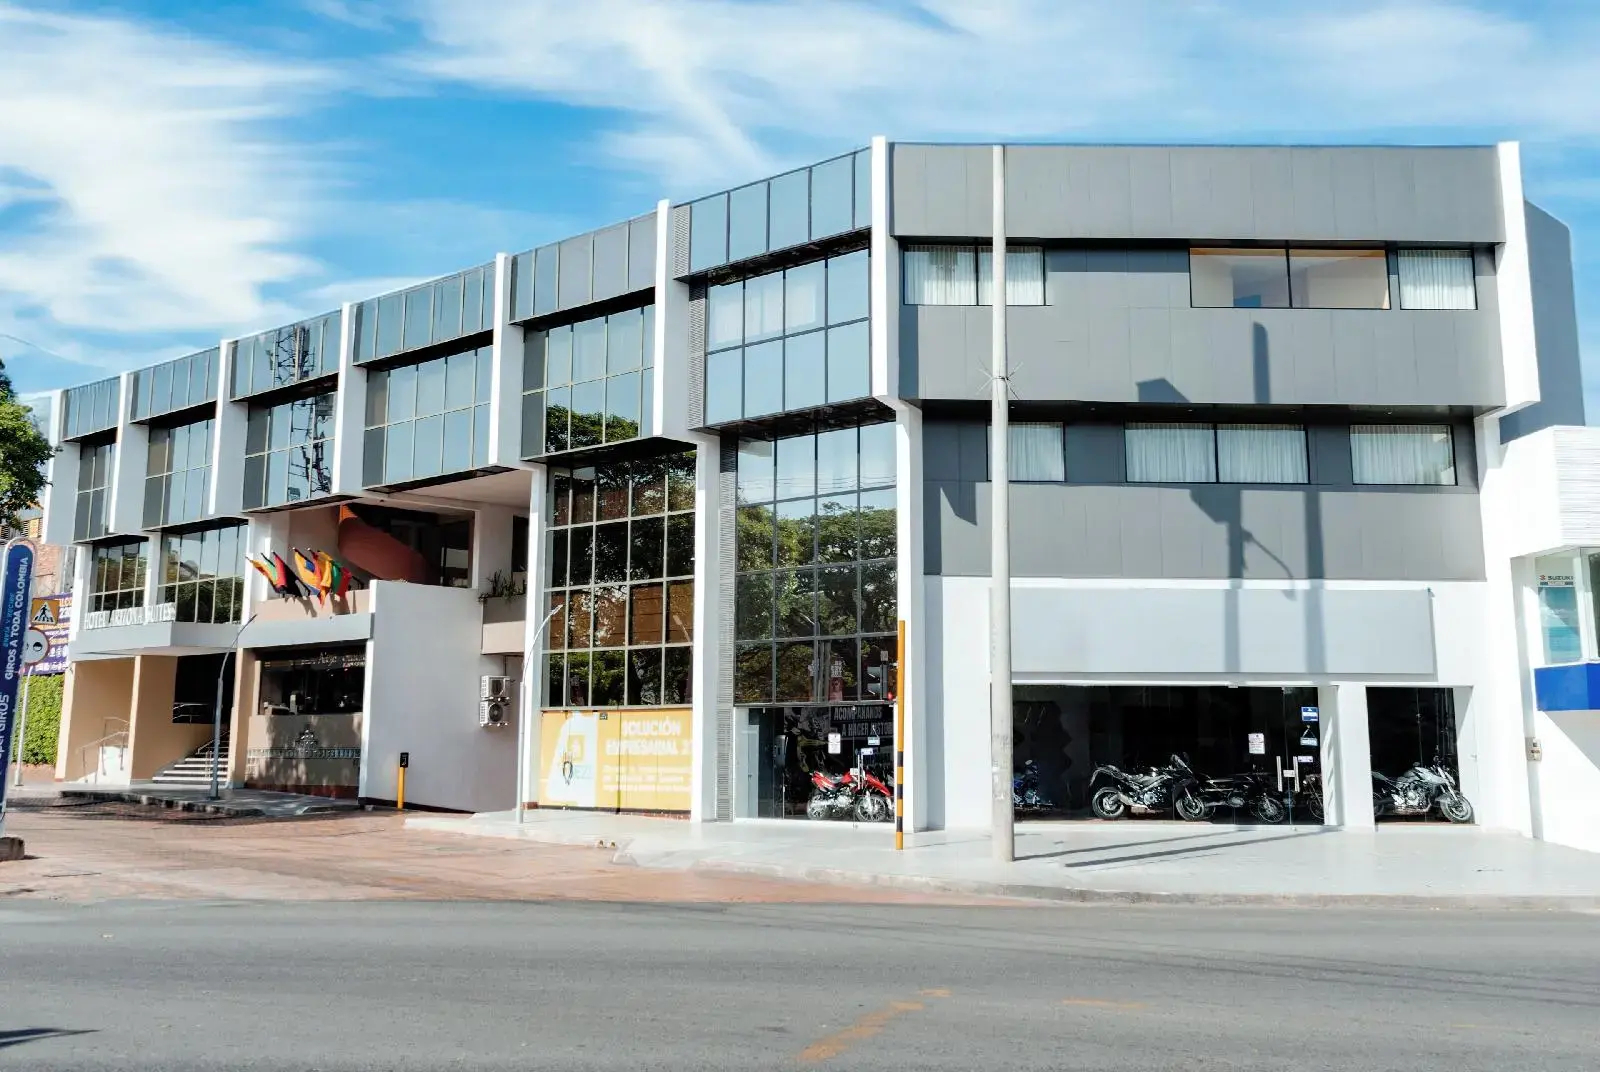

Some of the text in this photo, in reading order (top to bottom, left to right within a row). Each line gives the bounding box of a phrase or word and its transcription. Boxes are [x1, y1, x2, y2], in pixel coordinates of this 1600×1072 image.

[4, 557, 29, 680] GIROS A TODA COLOMBIA
[83, 611, 108, 630] HOTEL
[622, 716, 681, 737] SOLUCIÓN
